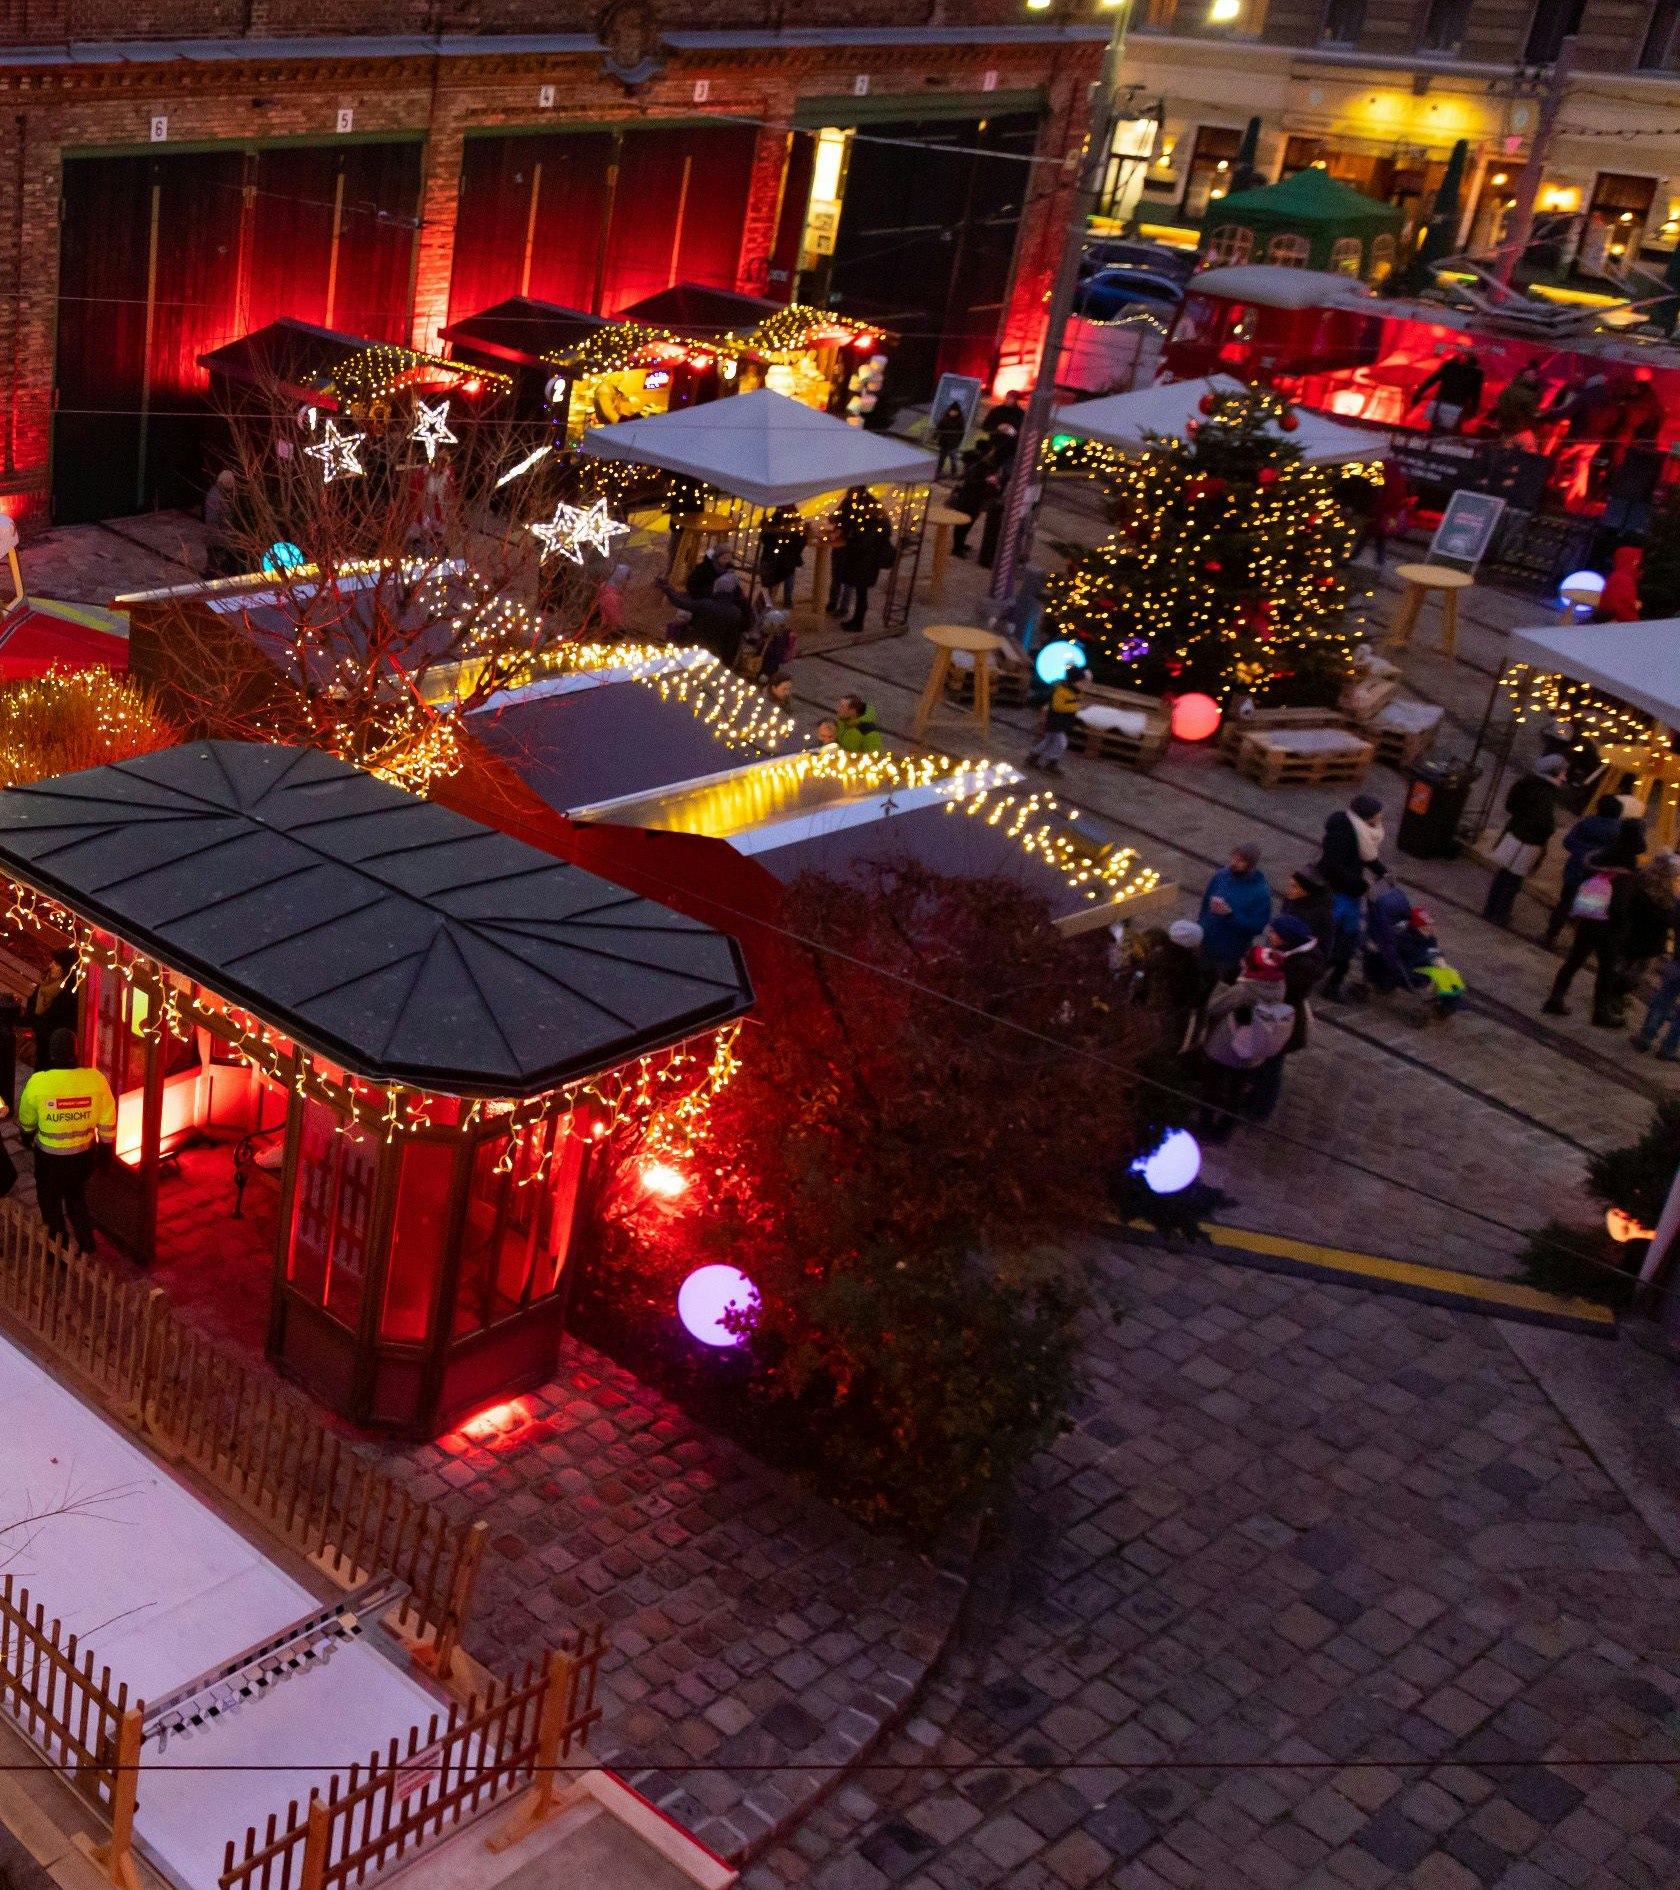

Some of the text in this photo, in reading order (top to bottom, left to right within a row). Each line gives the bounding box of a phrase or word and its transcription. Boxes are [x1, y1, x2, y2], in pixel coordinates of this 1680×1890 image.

[341, 113, 349, 128] 5
[155, 121, 163, 137] 6
[552, 379, 566, 403] 2
[45, 1110, 93, 1123] AUFSICHT
